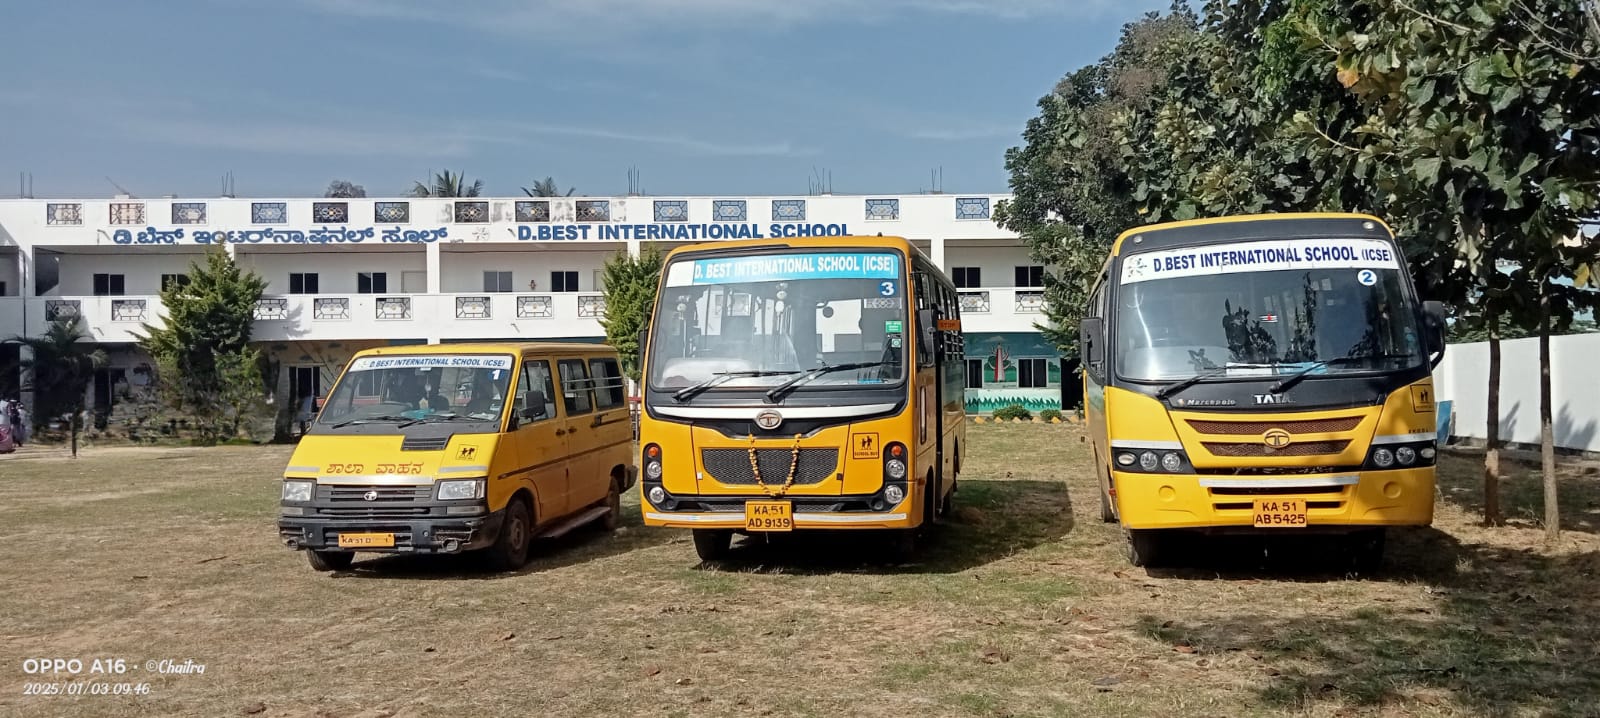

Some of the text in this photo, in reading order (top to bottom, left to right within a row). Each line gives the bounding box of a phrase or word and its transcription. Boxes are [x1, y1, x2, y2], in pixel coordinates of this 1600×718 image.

[518, 223, 853, 240] D.BEST INTERNATIONAL SCHOOL
[1153, 246, 1393, 272] D.BEST INTERNATIONAL SCHOOL (ICSE)
[706, 262, 733, 279] BEST
[735, 257, 815, 277] INTERNATIONAL
[818, 256, 859, 272] SCHOOL
[863, 255, 894, 274] (ICSE)
[1362, 271, 1373, 283] 2
[881, 281, 895, 296] 3
[394, 358, 449, 367] INTERNATIONAL
[452, 358, 481, 366] SCHOOL
[483, 359, 505, 367] (ICSE)
[492, 369, 501, 380] 1
[1253, 393, 1292, 405] TATA
